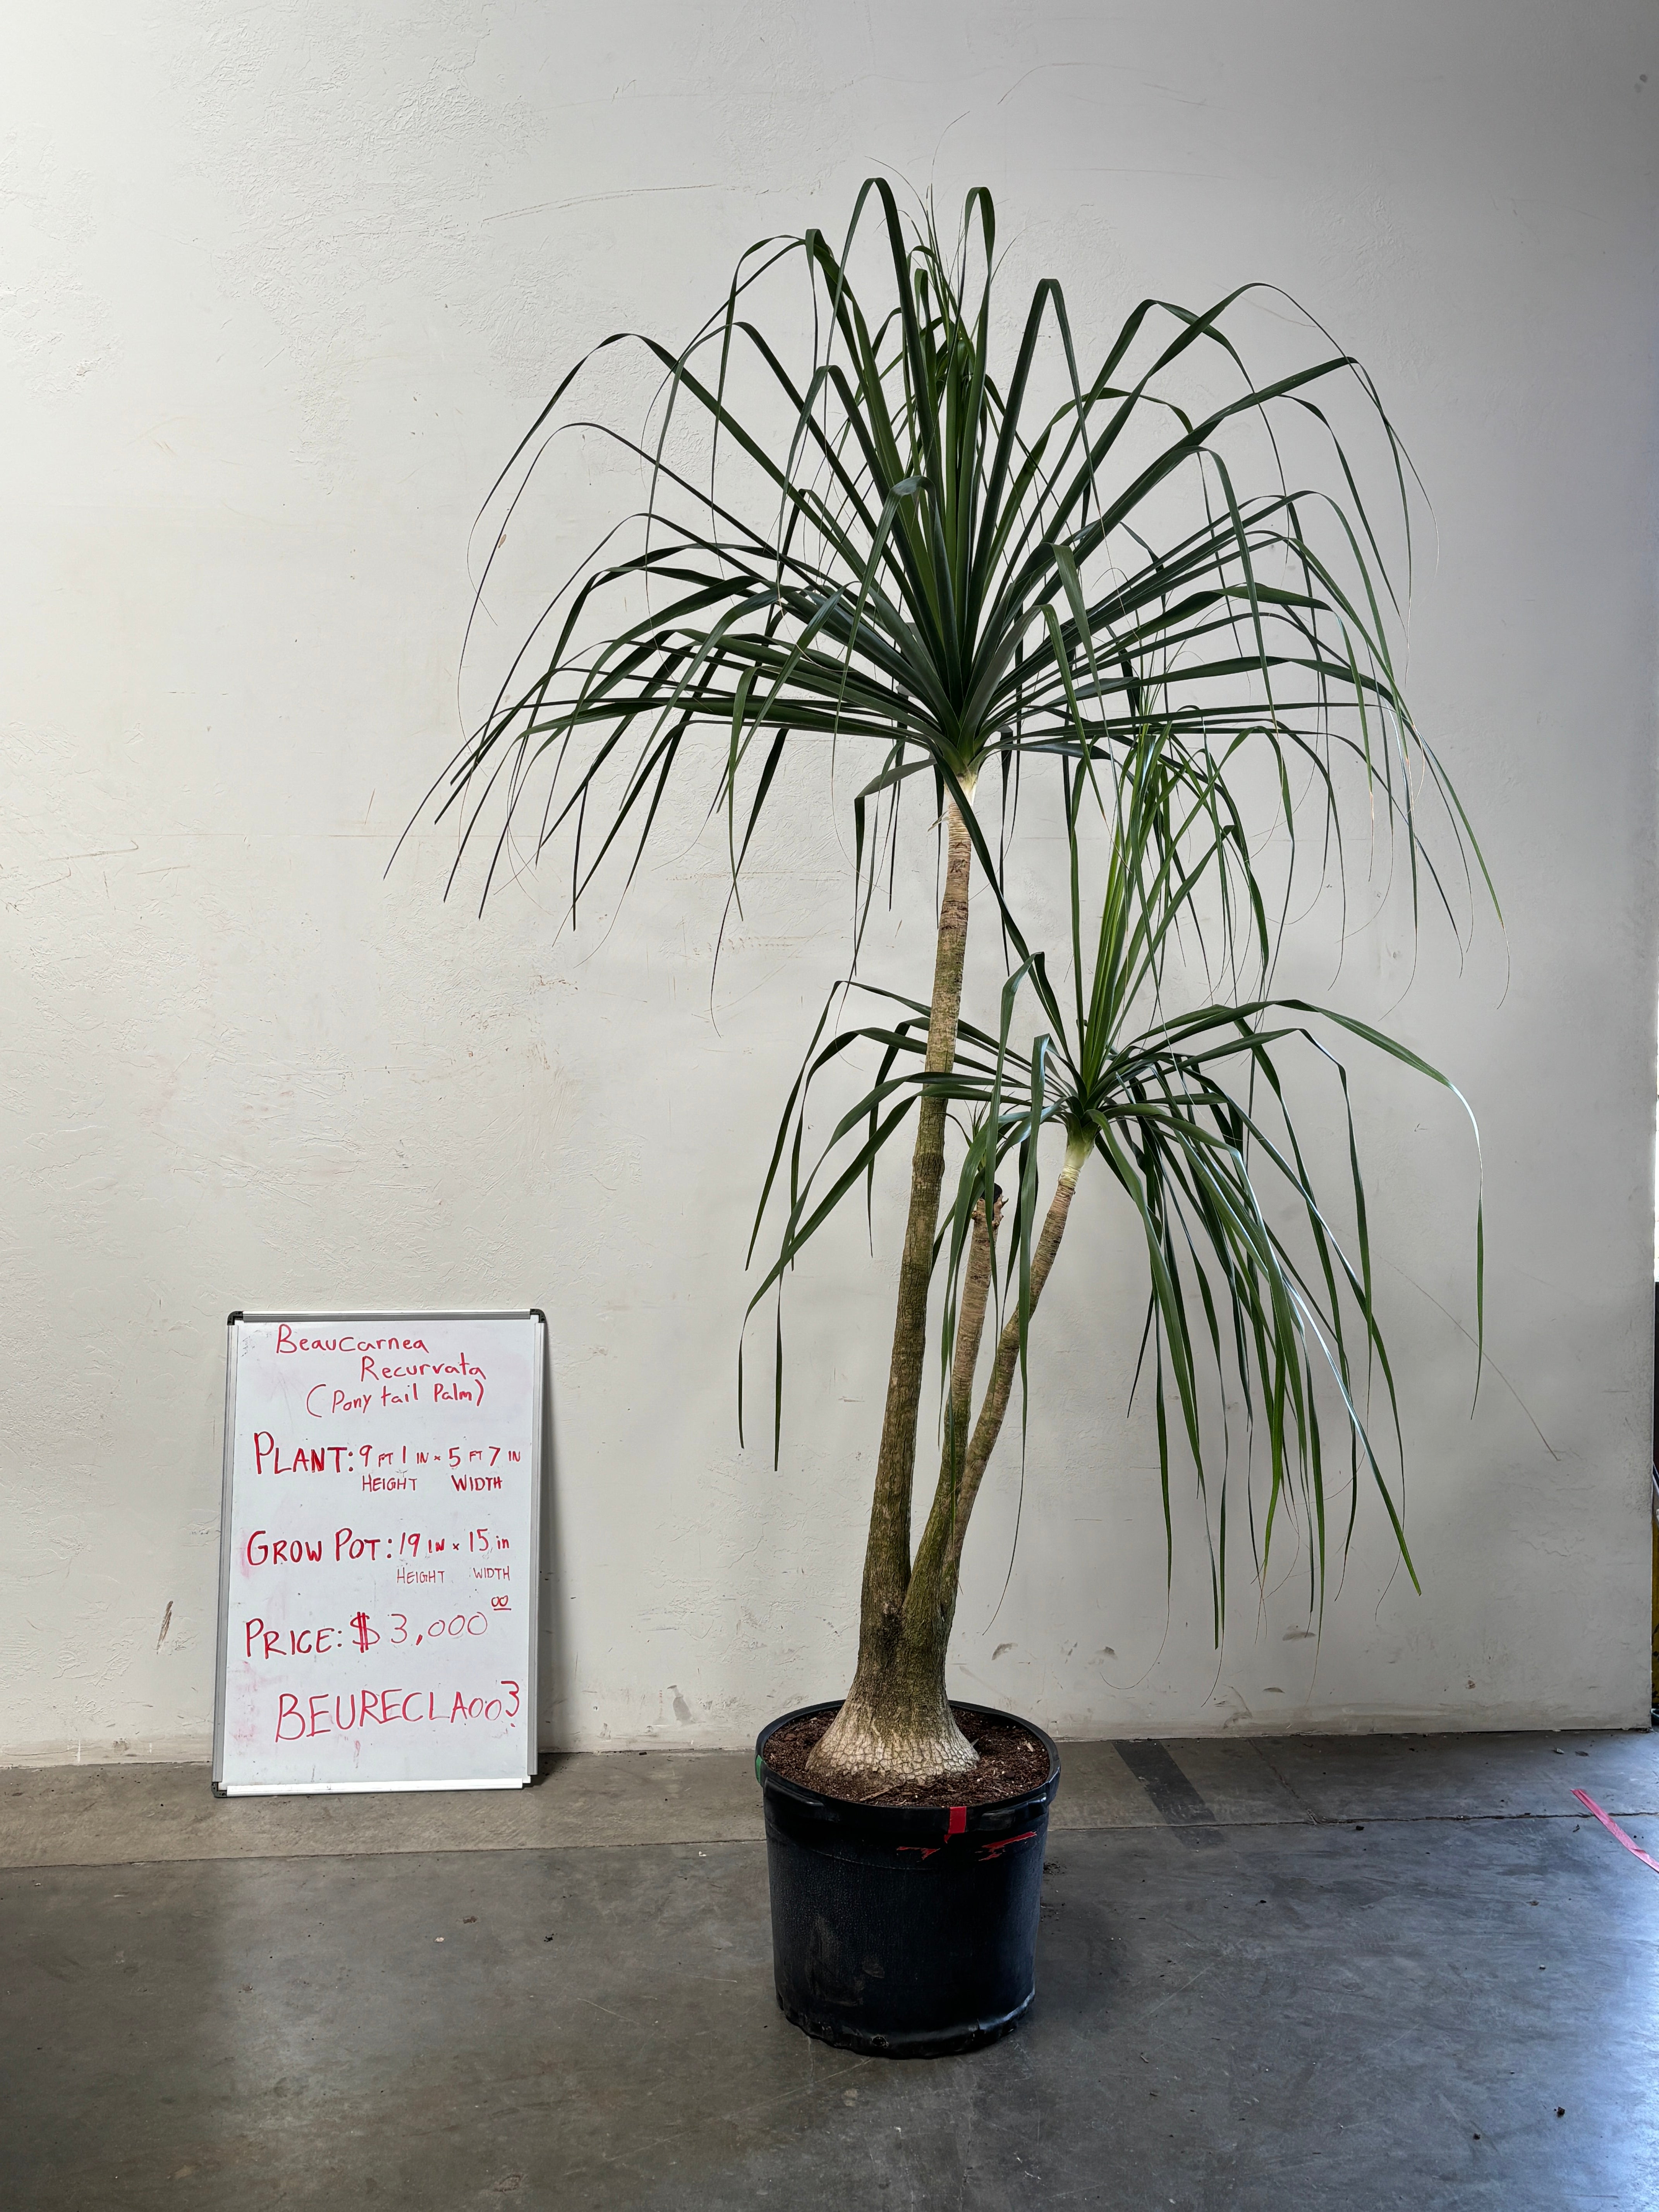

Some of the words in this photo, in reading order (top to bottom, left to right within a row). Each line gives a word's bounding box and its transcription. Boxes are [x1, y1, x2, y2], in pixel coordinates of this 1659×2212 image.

[361, 1353, 486, 1382] Recurvata
[381, 1382, 419, 1404] tail
[434, 1379, 483, 1406] Palm)
[254, 1432, 353, 1474] PLANT:
[359, 1445, 372, 1467] 9
[403, 1446, 406, 1463] 1
[417, 1453, 427, 1463] IN
[449, 1448, 460, 1467] 5
[489, 1447, 500, 1462] 7
[508, 1451, 520, 1462] IN
[362, 1474, 417, 1492] HEIGHT
[452, 1475, 502, 1491] WIDTH
[247, 1531, 321, 1565] GROW
[335, 1528, 392, 1561] POT:
[400, 1533, 420, 1557] 19
[428, 1539, 444, 1553] IN
[470, 1529, 488, 1551] 15
[496, 1535, 510, 1549] in
[397, 1567, 445, 1583] HEIGHT
[474, 1566, 510, 1581] WIDTH
[246, 1618, 341, 1659] PRICE:
